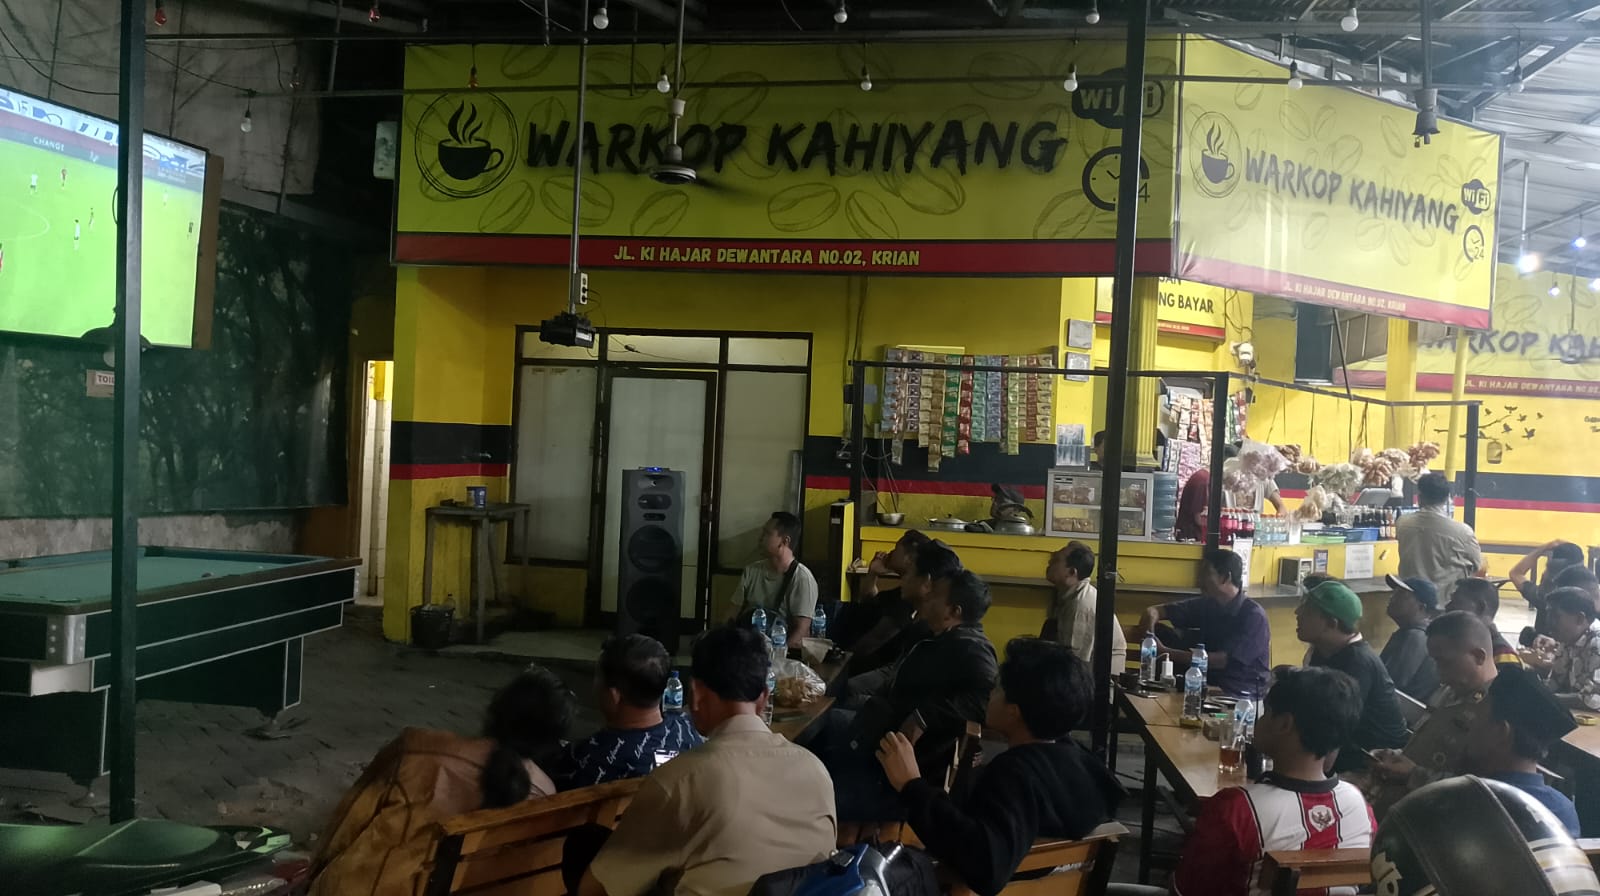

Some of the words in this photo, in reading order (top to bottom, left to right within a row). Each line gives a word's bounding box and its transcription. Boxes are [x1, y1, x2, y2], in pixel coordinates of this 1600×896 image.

[1080, 86, 1155, 110] Wii
[33, 136, 65, 152] CHANGE
[527, 119, 747, 175] WARKOP
[767, 119, 1069, 176] KAHIYANG
[1246, 147, 1342, 205] WARKOP
[1350, 178, 1459, 235] KAHIYANG
[1463, 187, 1489, 207] WiFi
[613, 246, 635, 261] JL.
[640, 246, 655, 261] KI
[660, 247, 712, 263] HAJAR
[717, 248, 813, 264] DEWANTARA
[818, 250, 866, 267] NO.02,
[871, 250, 920, 266] KRIAN
[1178, 294, 1214, 314] BAYAR
[1489, 380, 1518, 390] HAJAR
[1520, 382, 1573, 393] DEWANTARA
